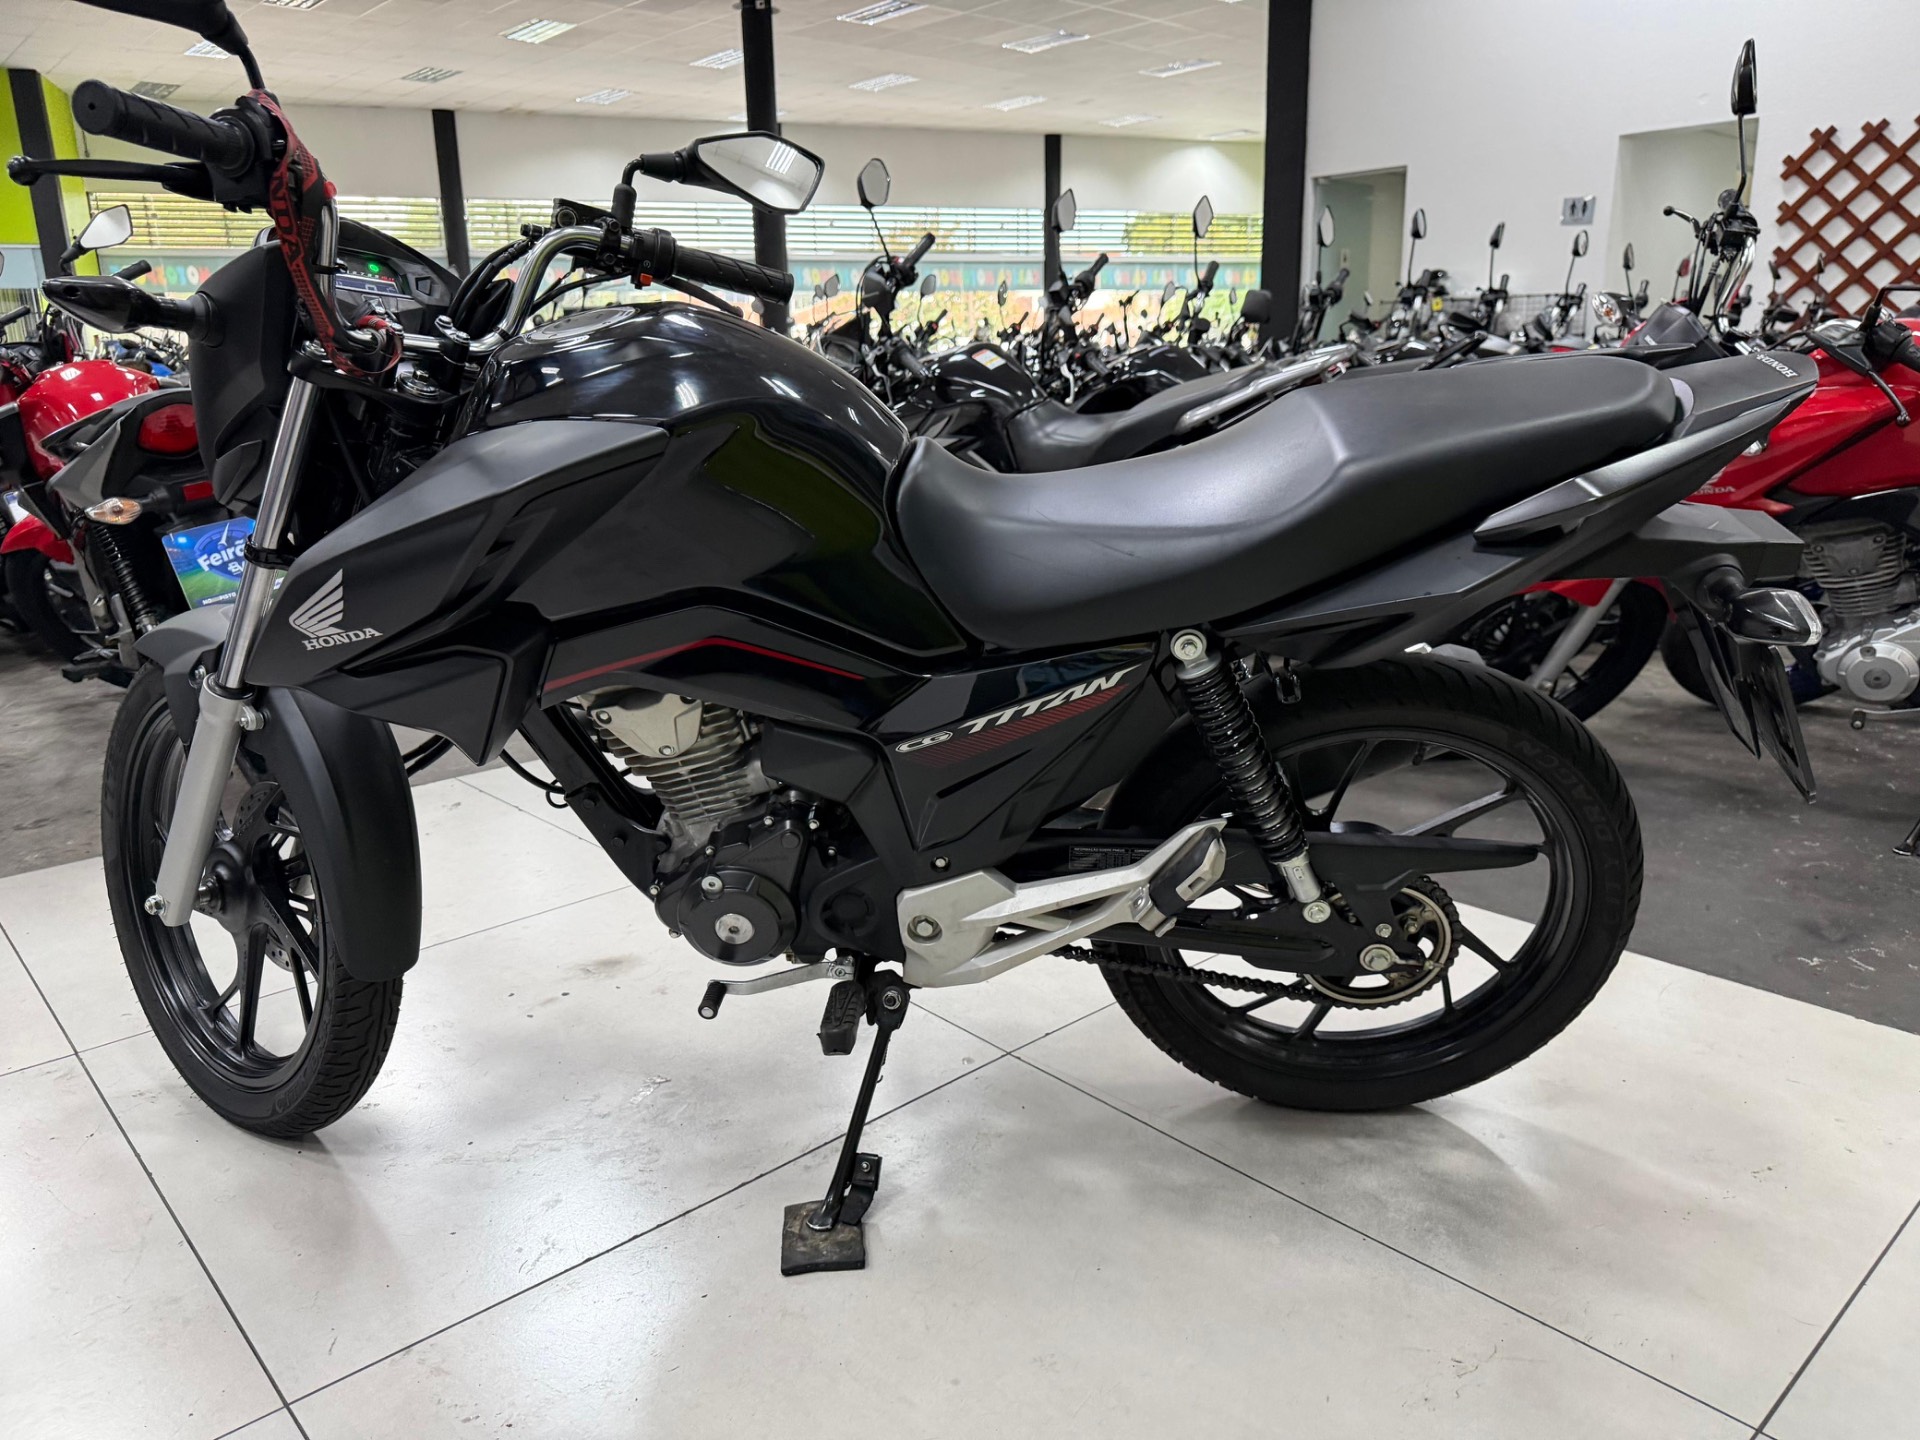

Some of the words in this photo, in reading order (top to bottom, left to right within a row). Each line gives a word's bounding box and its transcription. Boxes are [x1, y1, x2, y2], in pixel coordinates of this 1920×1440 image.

[1757, 353, 1798, 378] HONDA
[197, 539, 246, 572] Feirã
[302, 627, 384, 651] HONDA
[896, 730, 954, 753] CG
[958, 663, 1142, 735] TITAN
